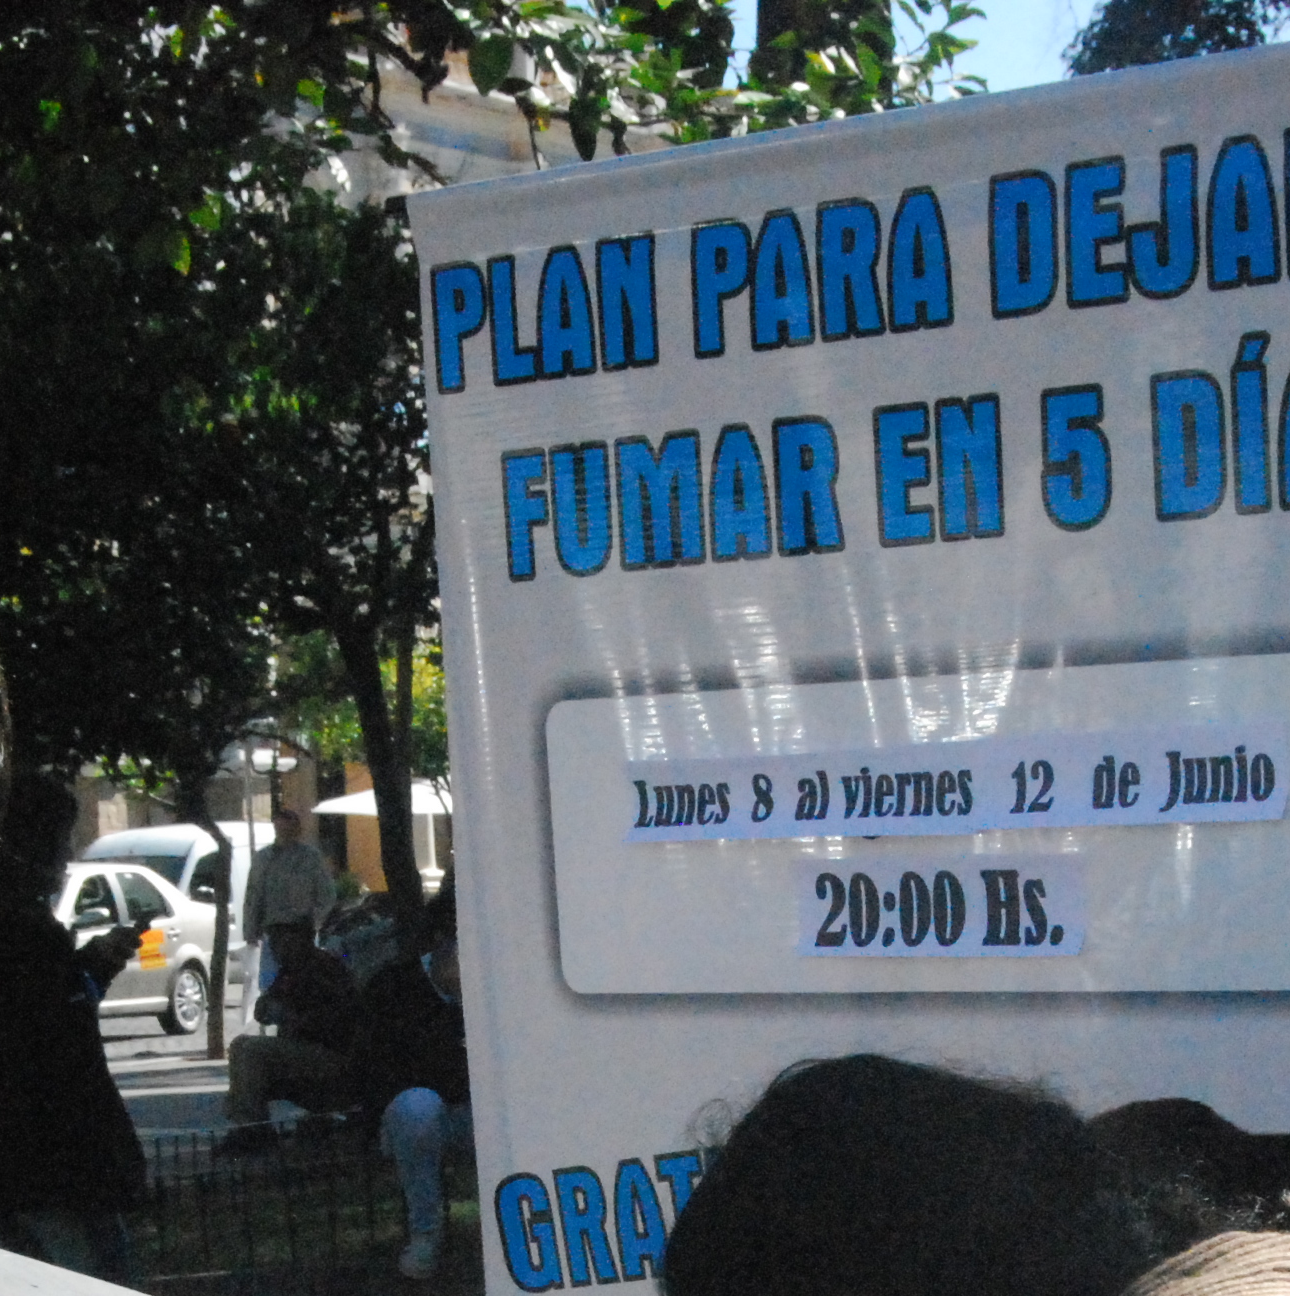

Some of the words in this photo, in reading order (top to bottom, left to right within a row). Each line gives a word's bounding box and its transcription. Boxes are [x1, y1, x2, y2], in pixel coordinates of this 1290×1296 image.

[430, 234, 658, 395] PLAN
[691, 186, 955, 359] PARA
[502, 415, 845, 582] FUMAR
[873, 393, 1005, 548] EN
[1041, 384, 1112, 532] 5
[634, 777, 730, 828] Lunes
[750, 774, 774, 823] 8
[794, 770, 830, 821] al
[841, 765, 973, 820] viernes
[1010, 759, 1055, 814] 12
[1092, 755, 1140, 810] de
[1158, 745, 1276, 812] Junio
[814, 870, 967, 947] 20:00
[981, 869, 1064, 946] Hs.
[494, 1150, 713, 1292] GRAT
